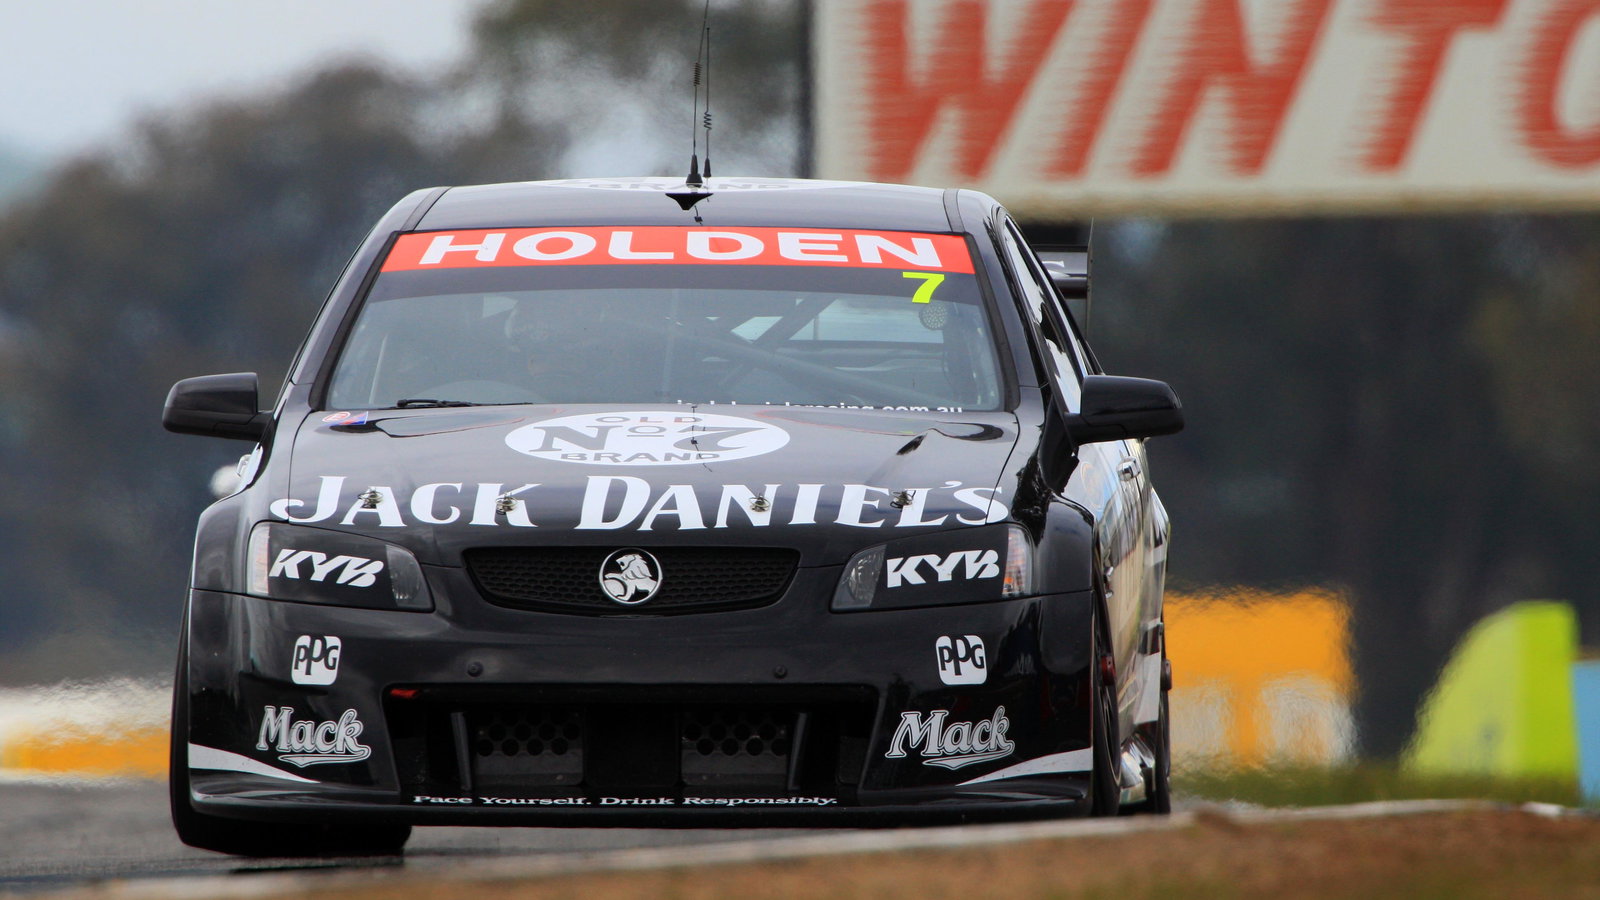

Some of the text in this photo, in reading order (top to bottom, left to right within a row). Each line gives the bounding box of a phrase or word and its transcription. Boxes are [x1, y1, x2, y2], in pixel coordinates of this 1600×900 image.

[419, 230, 943, 268] HOLDEN
[902, 271, 945, 304] 7
[595, 415, 703, 424] OLD
[560, 452, 721, 463] BRAND
[269, 475, 1009, 531] JACK DANIEL'S
[269, 548, 384, 588] KYB
[886, 549, 1000, 588] KYB
[294, 634, 339, 676] PPG
[938, 634, 985, 676] PPG
[256, 705, 371, 767] Mack
[885, 705, 1015, 770] Mack
[413, 795, 838, 807] Pace Yourself. Drink Responsibly.
